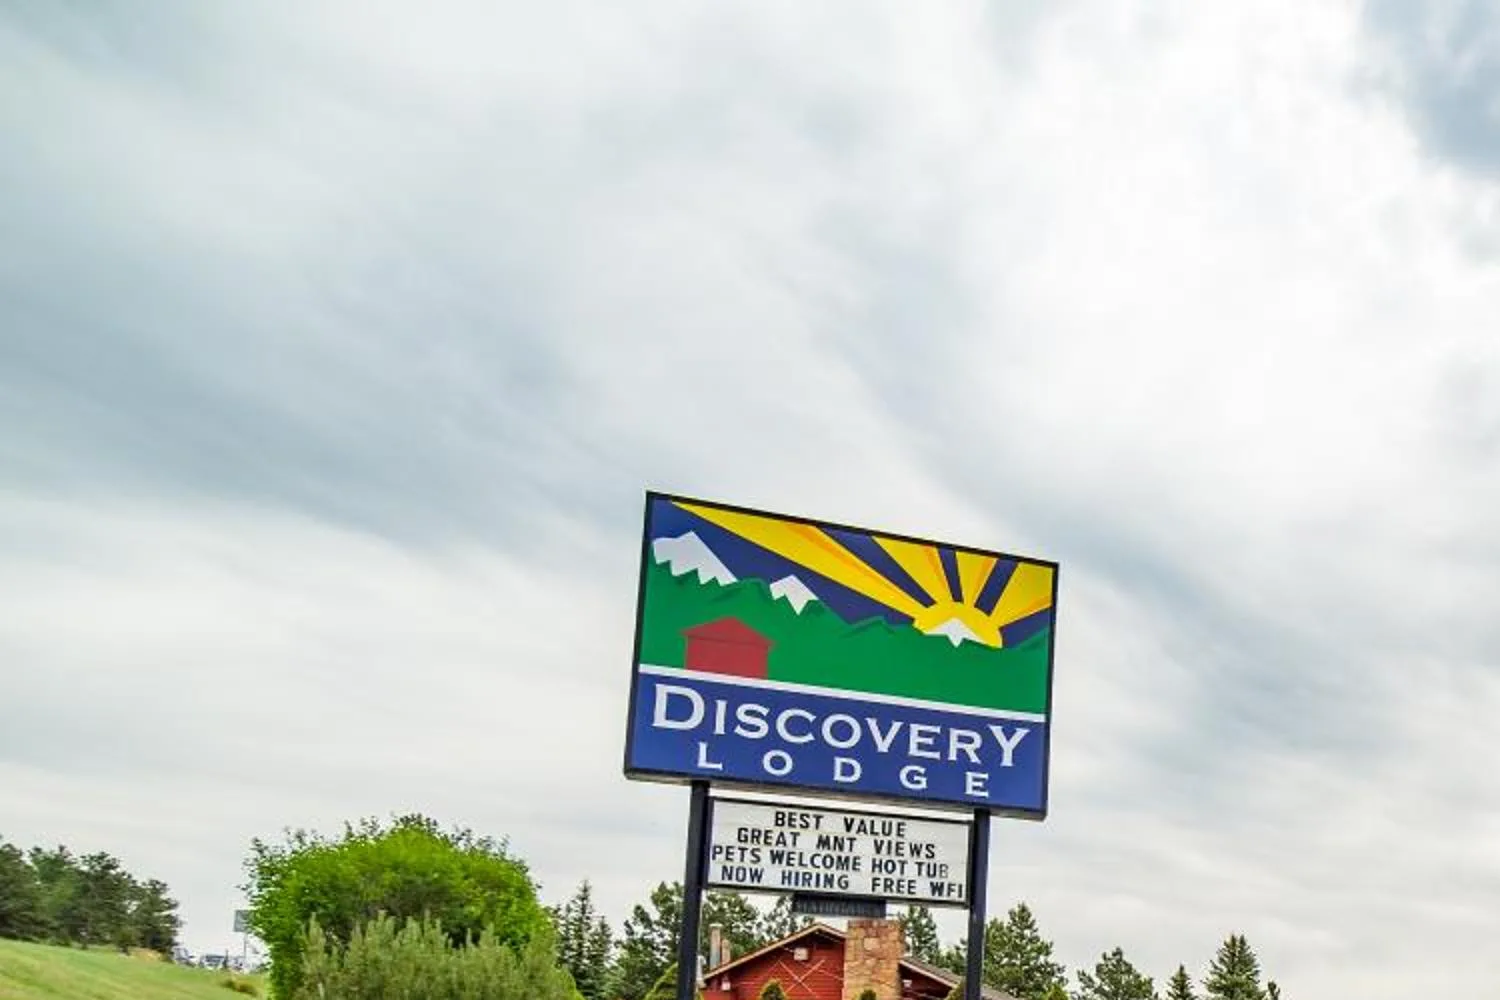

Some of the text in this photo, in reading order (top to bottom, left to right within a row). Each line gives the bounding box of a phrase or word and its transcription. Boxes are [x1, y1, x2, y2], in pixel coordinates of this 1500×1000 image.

[652, 683, 1031, 767] DISCOVERY
[696, 742, 989, 798] LODGE
[774, 811, 907, 838] BEST VALUE
[737, 827, 936, 859] GREAT MNT VIEWS
[711, 845, 949, 879] PETS WELCOME HOT TUB
[721, 865, 764, 884] NOW
[781, 870, 850, 890] HIRING
[871, 877, 917, 895] FREE
